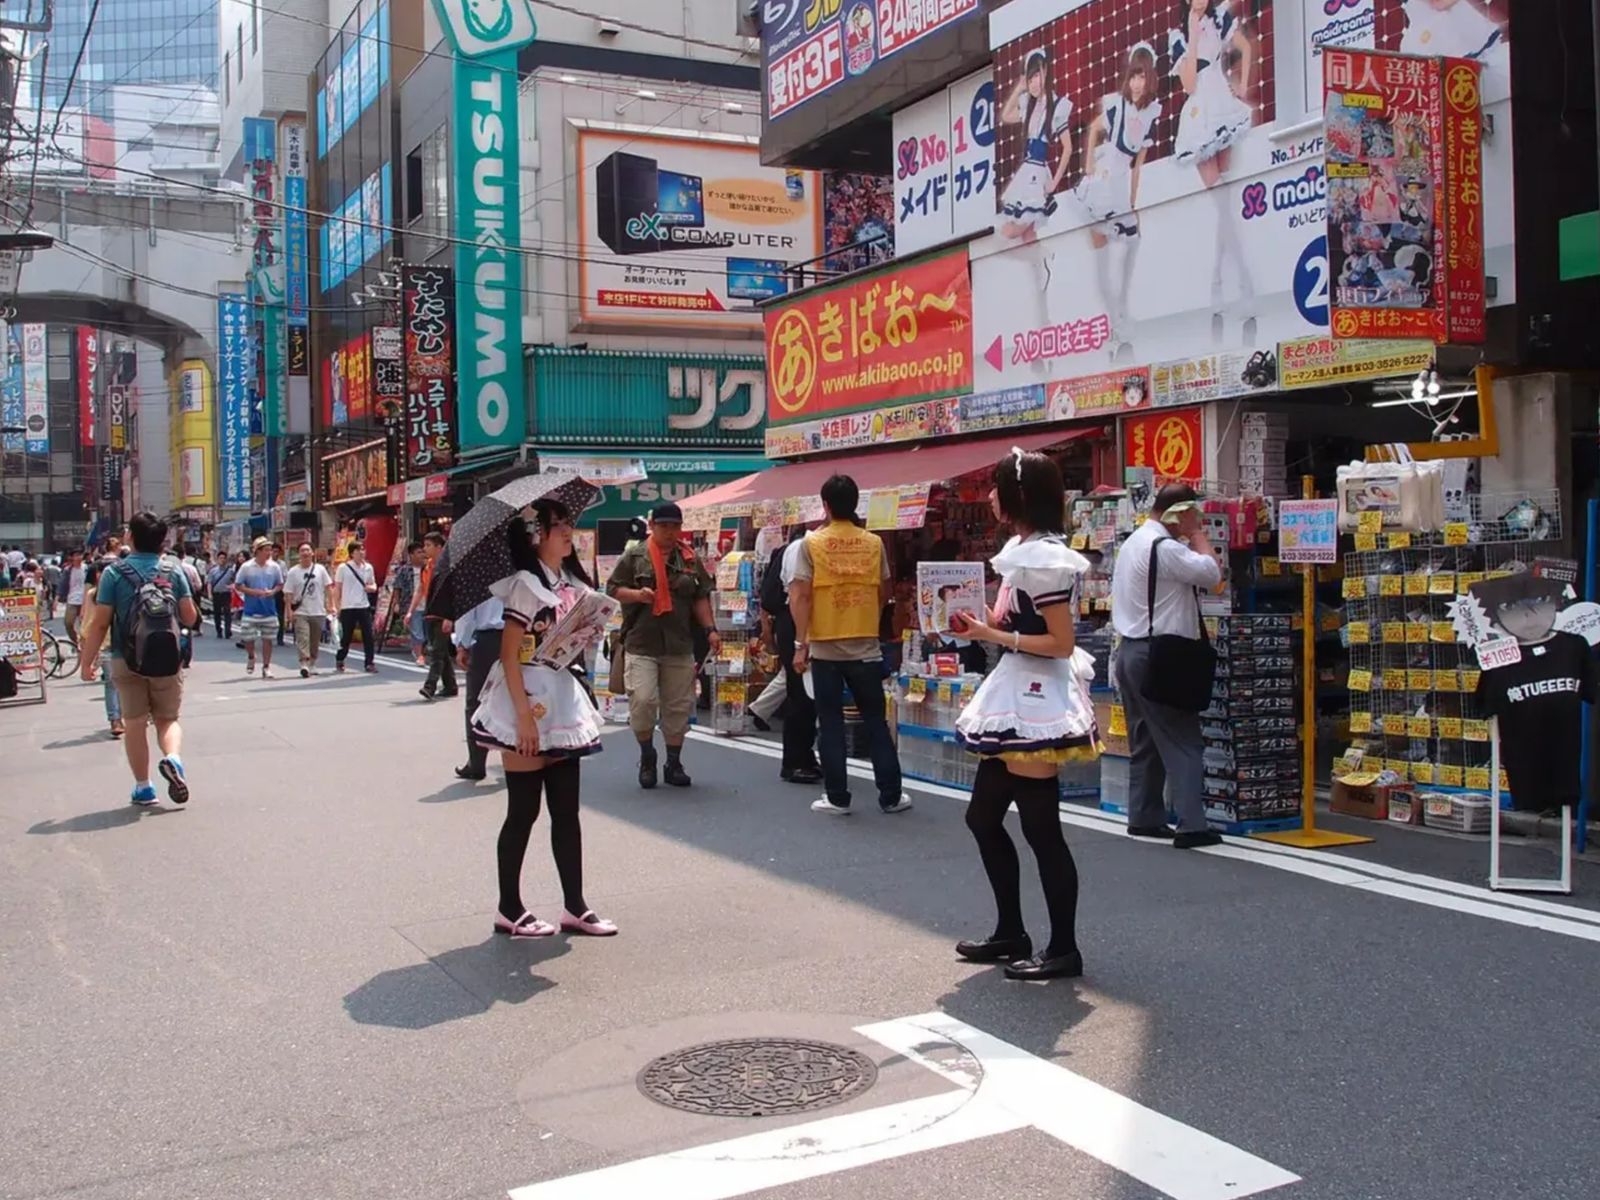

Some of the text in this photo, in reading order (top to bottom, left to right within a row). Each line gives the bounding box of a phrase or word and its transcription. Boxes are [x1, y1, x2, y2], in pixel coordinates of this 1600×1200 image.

[1311, 8, 1375, 44] maidreamin
[771, 37, 840, 112] 受付3F
[1326, 52, 1382, 93] 同人
[1385, 59, 1426, 86] 音楽
[470, 74, 510, 437] TSUKUMO
[1011, 314, 1111, 364] 入り口は左手
[821, 350, 965, 396] www.akibaoo.co.jp
[111, 393, 123, 426] DVD
[408, 393, 434, 466] ハンバーグ
[1481, 645, 1520, 667] ¥1050
[1507, 677, 1581, 703] 俺TUEEEE!
